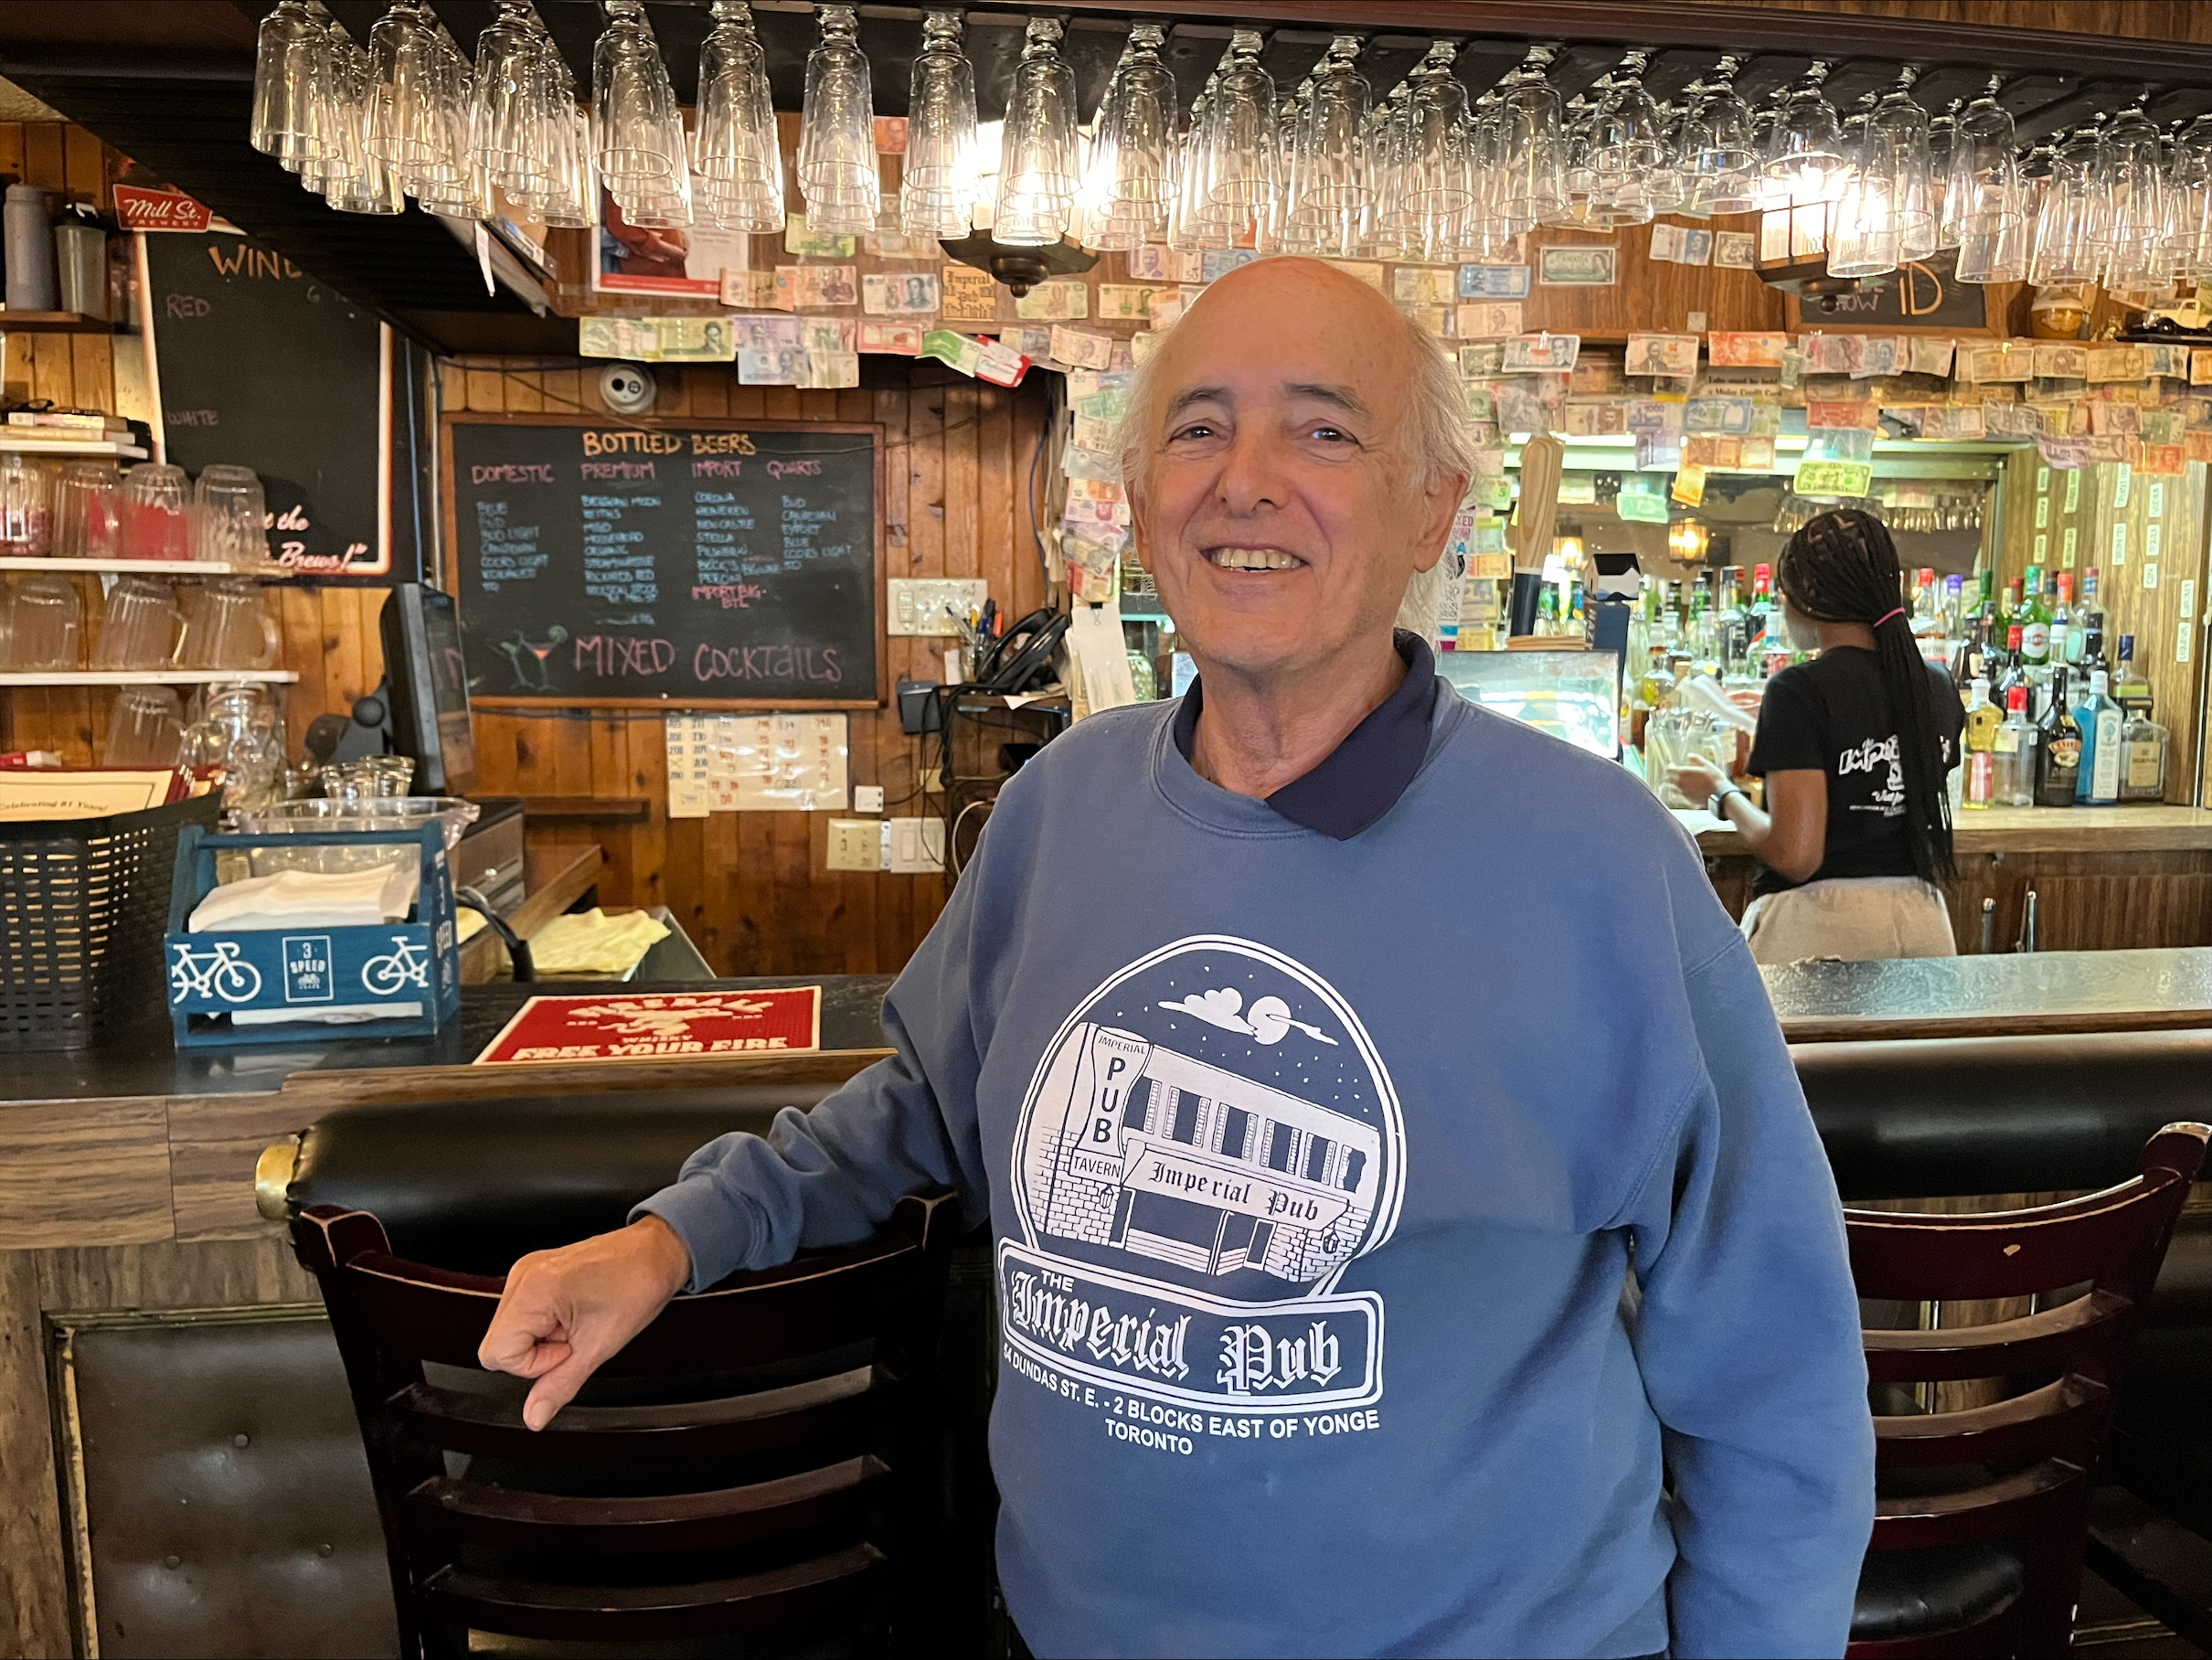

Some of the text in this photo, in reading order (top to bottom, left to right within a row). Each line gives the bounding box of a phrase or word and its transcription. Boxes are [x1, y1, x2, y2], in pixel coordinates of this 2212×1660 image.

[122, 198, 201, 219] Mill St.
[1898, 261, 1943, 315] ID
[167, 293, 210, 318] RED
[582, 431, 757, 456] BOTTLED BEERS
[472, 463, 555, 484] DOMESTIC
[581, 460, 655, 482] PREMIUM
[691, 460, 741, 479] IMPORT
[767, 460, 822, 481] QUARTS
[576, 635, 675, 676] MIXED
[303, 942, 312, 959] 3
[290, 960, 325, 974] SPEED
[512, 1038, 787, 1060] FREE YOUR FIRE
[1099, 1036, 1146, 1054] IMPERIAL
[1092, 1057, 1126, 1143] PUB
[1074, 1156, 1121, 1178] TAVERN
[1148, 1161, 1319, 1221] Imperial Pub
[1041, 1270, 1074, 1293] THE
[1011, 1270, 1342, 1396] Imperial Pub
[1013, 1352, 1058, 1392] DUNDAS
[1060, 1379, 1080, 1401] ST.
[1085, 1388, 1100, 1408] E.
[1113, 1396, 1124, 1415] 2
[1128, 1399, 1204, 1433] BLOCKS
[1208, 1417, 1264, 1439] EAST
[1270, 1418, 1299, 1439] OF
[1303, 1409, 1380, 1436] YONGE
[1104, 1419, 1193, 1455] TORONTO
